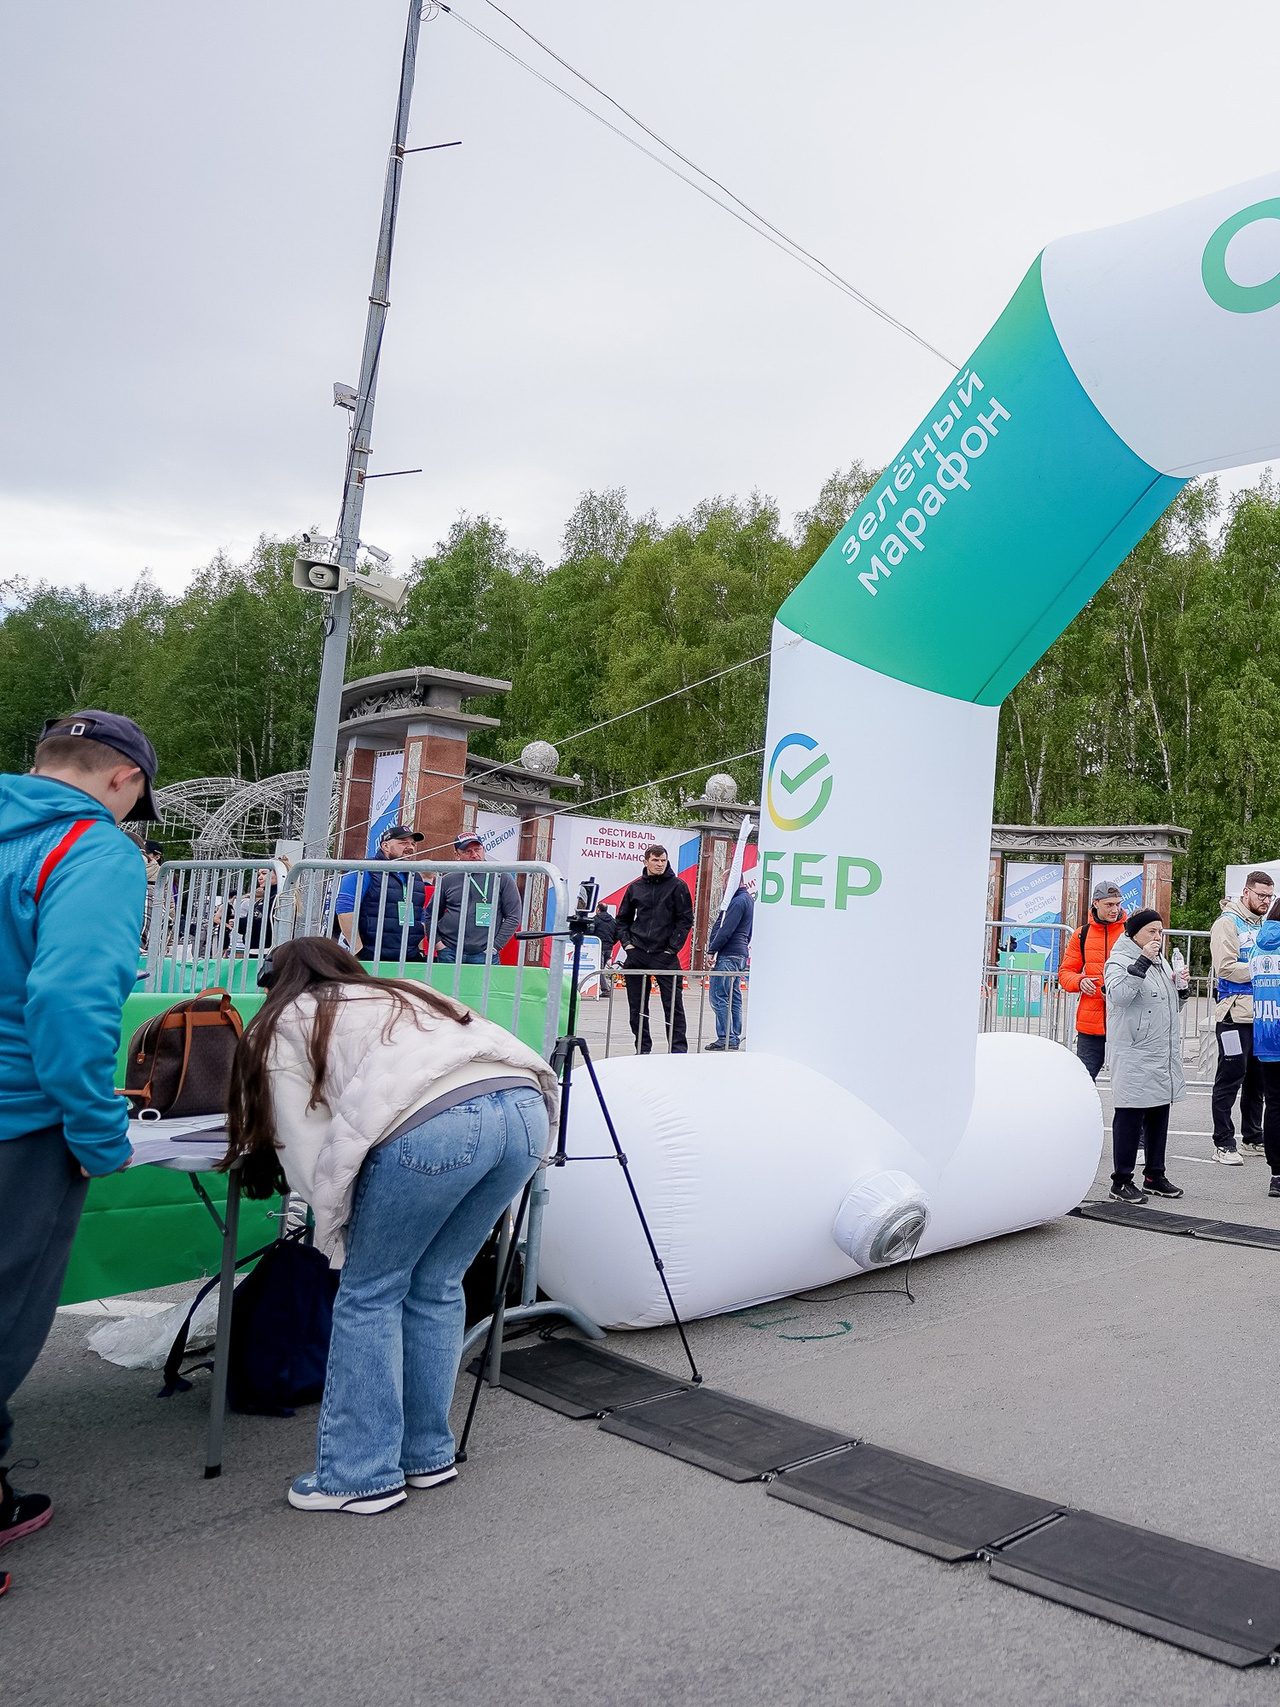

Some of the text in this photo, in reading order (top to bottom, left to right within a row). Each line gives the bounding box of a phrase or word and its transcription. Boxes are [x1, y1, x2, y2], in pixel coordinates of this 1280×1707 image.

[841, 368, 985, 565] зелёный
[857, 396, 1012, 596] марафон
[484, 827, 516, 852] ОВЕКОМ
[585, 836, 626, 849] ПЕРВЫХ
[628, 841, 635, 850] В
[598, 827, 656, 841] ФЕСТИВАЛЬ
[581, 848, 646, 863] ХАНТЫ-МАНС
[757, 850, 883, 911] БЕР
[1009, 869, 1059, 899] БЫТЬ ВМЕСТЕ
[1024, 895, 1045, 908] БЫТЬ
